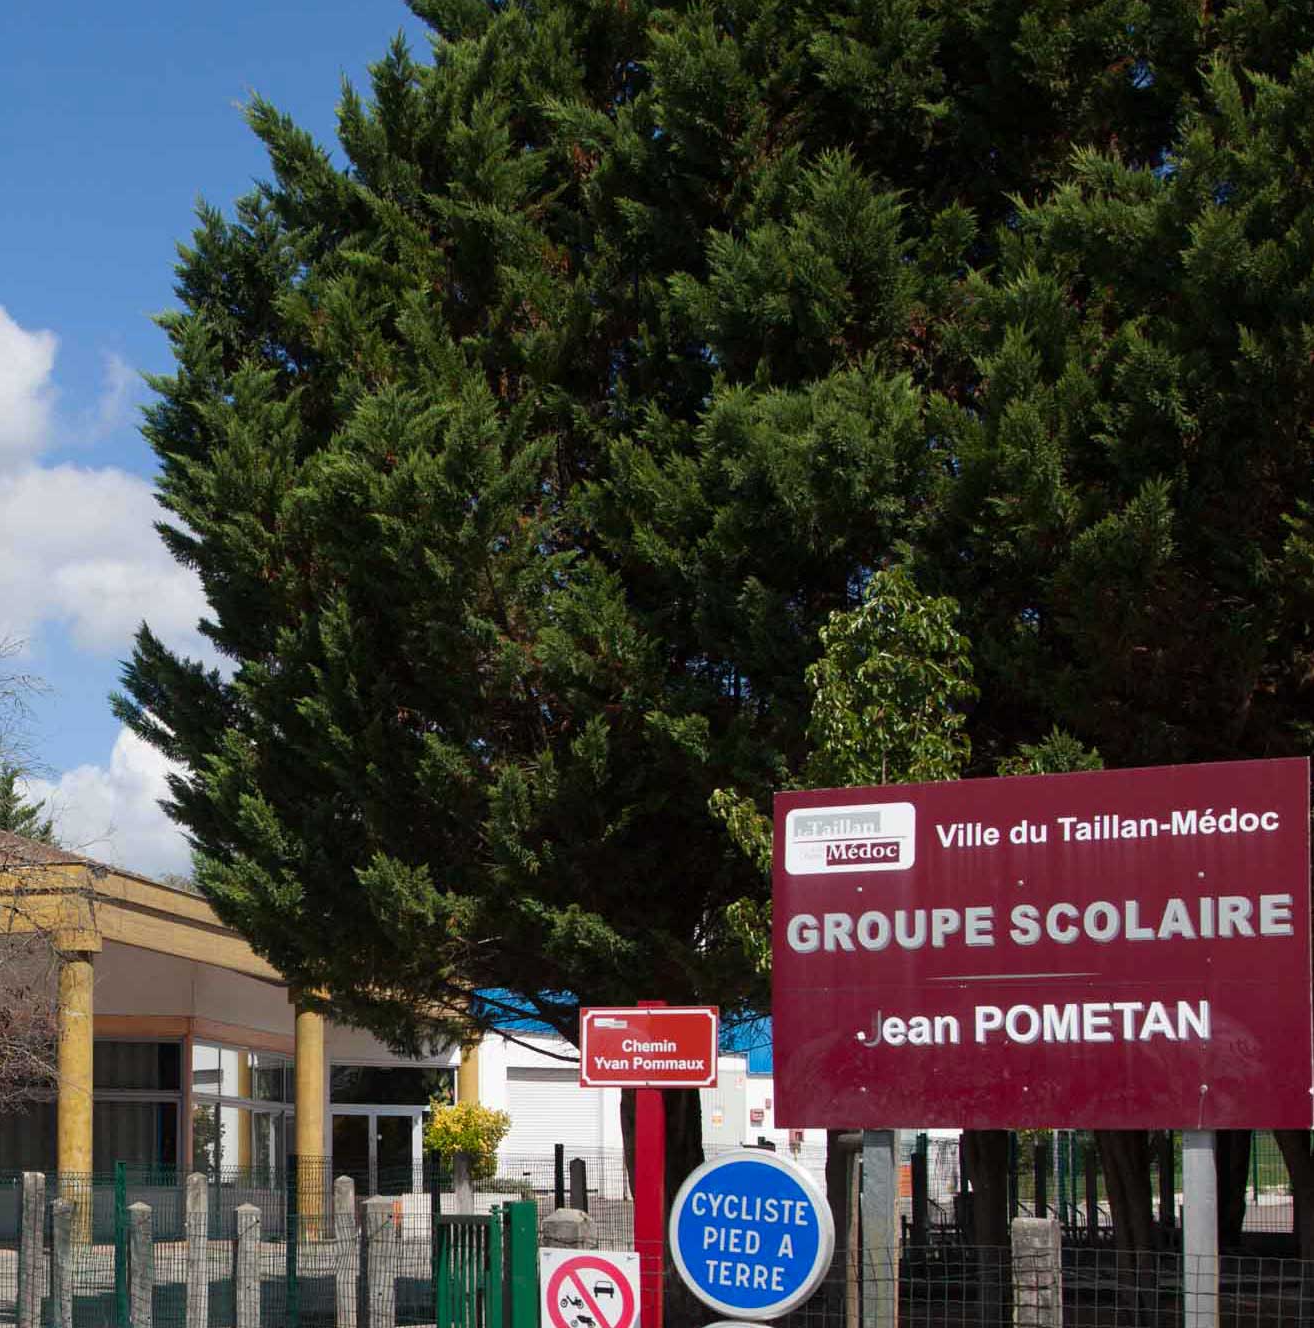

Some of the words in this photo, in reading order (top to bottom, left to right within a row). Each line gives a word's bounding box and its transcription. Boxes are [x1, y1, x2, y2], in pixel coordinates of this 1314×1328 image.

[936, 822, 1000, 848] Ville
[1010, 820, 1047, 845] du
[1057, 807, 1279, 841] Taillan-Médoc
[828, 841, 898, 861] Médoc
[787, 906, 995, 952] GROUPE
[1010, 894, 1294, 945] SCOLAIRE
[857, 1010, 960, 1047] Jean
[974, 1000, 1211, 1044] POMETAN
[594, 1056, 629, 1070] Yvan
[633, 1056, 705, 1070] Pommaux
[622, 1040, 677, 1053] Chemin
[692, 1191, 808, 1226] CYCLISTE
[703, 1226, 760, 1254] PIED
[777, 1233, 794, 1259] A
[706, 1259, 785, 1292] TERRE
